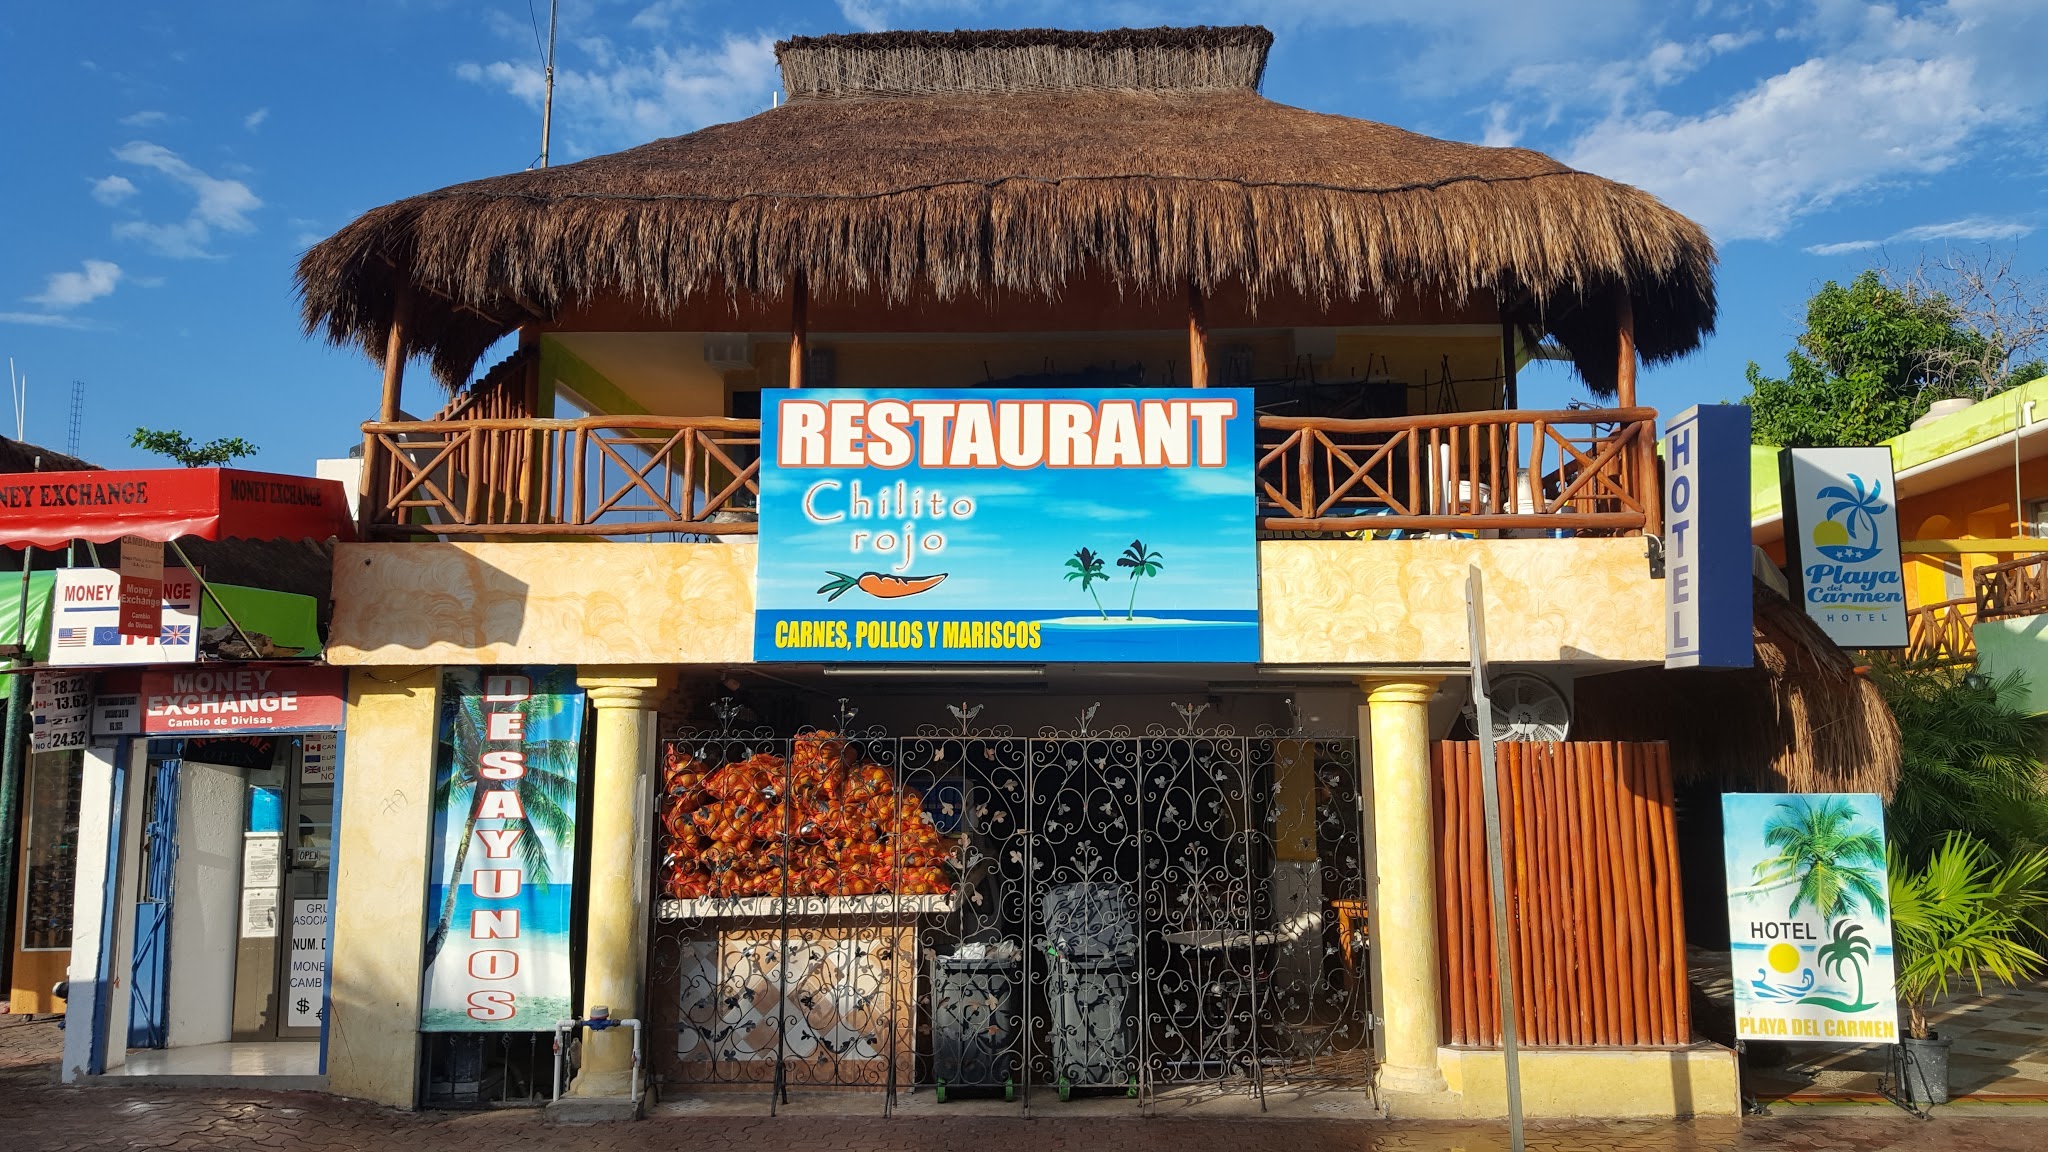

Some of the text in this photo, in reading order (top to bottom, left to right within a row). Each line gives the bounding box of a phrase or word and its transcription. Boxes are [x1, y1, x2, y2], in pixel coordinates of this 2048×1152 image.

[779, 400, 1237, 468] RESTAURANT
[40, 481, 148, 507] EXCHANGE
[230, 480, 322, 507] MONEY EXCHANGE
[803, 480, 975, 522] Chilito
[1671, 428, 1691, 648] HOTEL
[853, 523, 945, 571] rojo
[1806, 564, 1899, 591] Playa
[64, 585, 114, 601] MONEY
[126, 584, 153, 597] Money
[1807, 587, 1902, 603] Carmen
[1827, 584, 1843, 592] del
[121, 594, 160, 608] Exchange
[135, 621, 153, 629] Divisas
[1827, 613, 1887, 622] HOTEL
[775, 620, 1041, 651] CARNES, POLLOS Y MARISCOS
[53, 678, 85, 694] 18.22
[173, 670, 273, 694] MONEY
[147, 690, 298, 717] EXCHANGE
[168, 716, 273, 727] Cambio de Divisas
[52, 731, 85, 748] 24.52
[299, 851, 319, 861] OPEN
[466, 674, 532, 1021] DESAYUNOS
[1751, 921, 1817, 940] HOTEL
[292, 938, 318, 950] NUM.
[293, 961, 325, 971] MONE
[290, 977, 322, 987] CAMB
[1739, 1016, 1894, 1038] PLAYA DEL CARMEN
